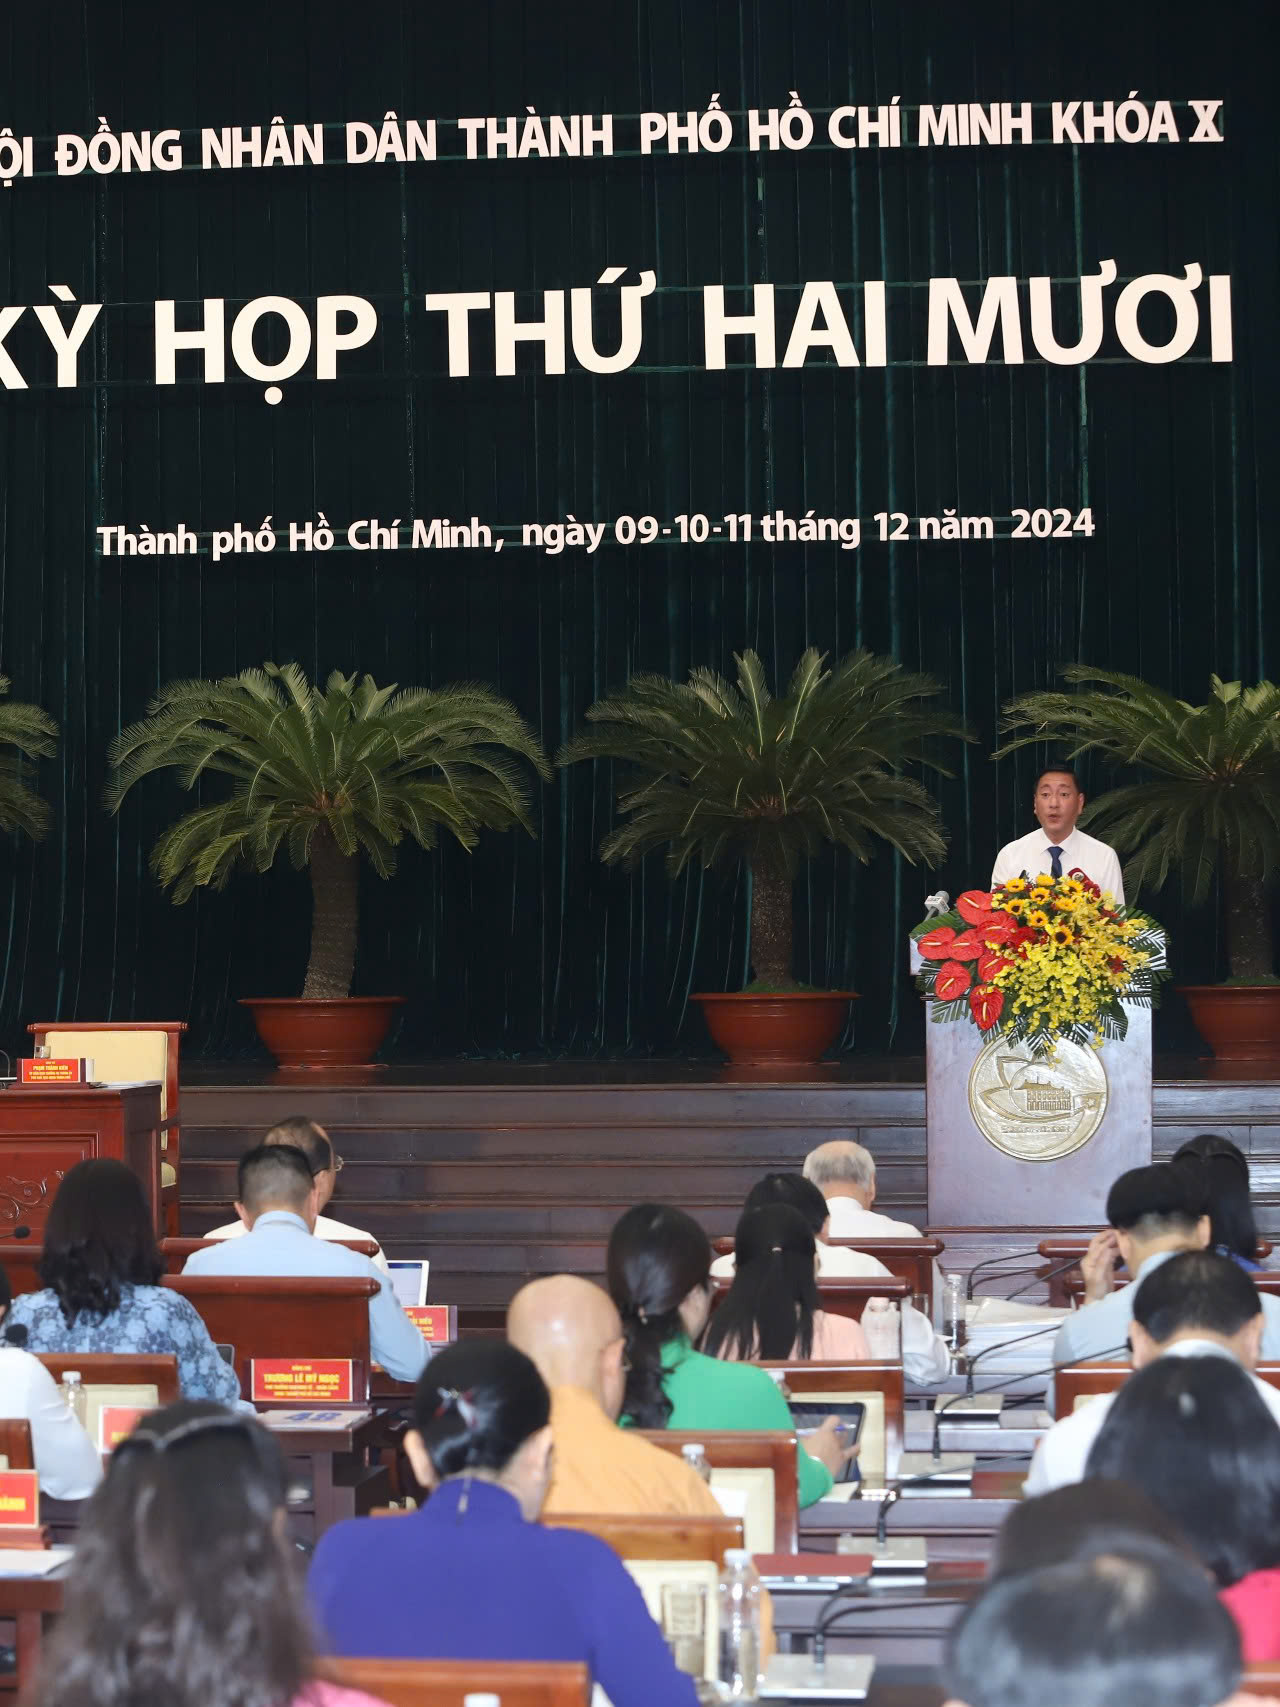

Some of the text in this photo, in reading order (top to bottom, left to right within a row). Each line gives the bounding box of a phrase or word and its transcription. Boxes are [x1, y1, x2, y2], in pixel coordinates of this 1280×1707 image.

[54, 116, 183, 176] ĐỒNG
[201, 115, 324, 170] NHÂN
[345, 110, 437, 164] DÂN
[457, 106, 614, 160] THÀNH
[640, 92, 733, 155] PHỐ
[748, 90, 814, 152] HỒ
[827, 95, 901, 149] CHÍ
[918, 102, 1033, 147] MINH
[1051, 90, 1180, 144] KHÓA
[1187, 99, 1225, 143] X
[154, 295, 378, 406] HỌP
[425, 267, 657, 378] THỨ
[703, 280, 887, 371] HAI
[927, 258, 1233, 366] MƯƠI
[96, 507, 1096, 562] Thành phố Hồ Chí Minh, ngày 09-10-11 tháng 12 năm 2024
